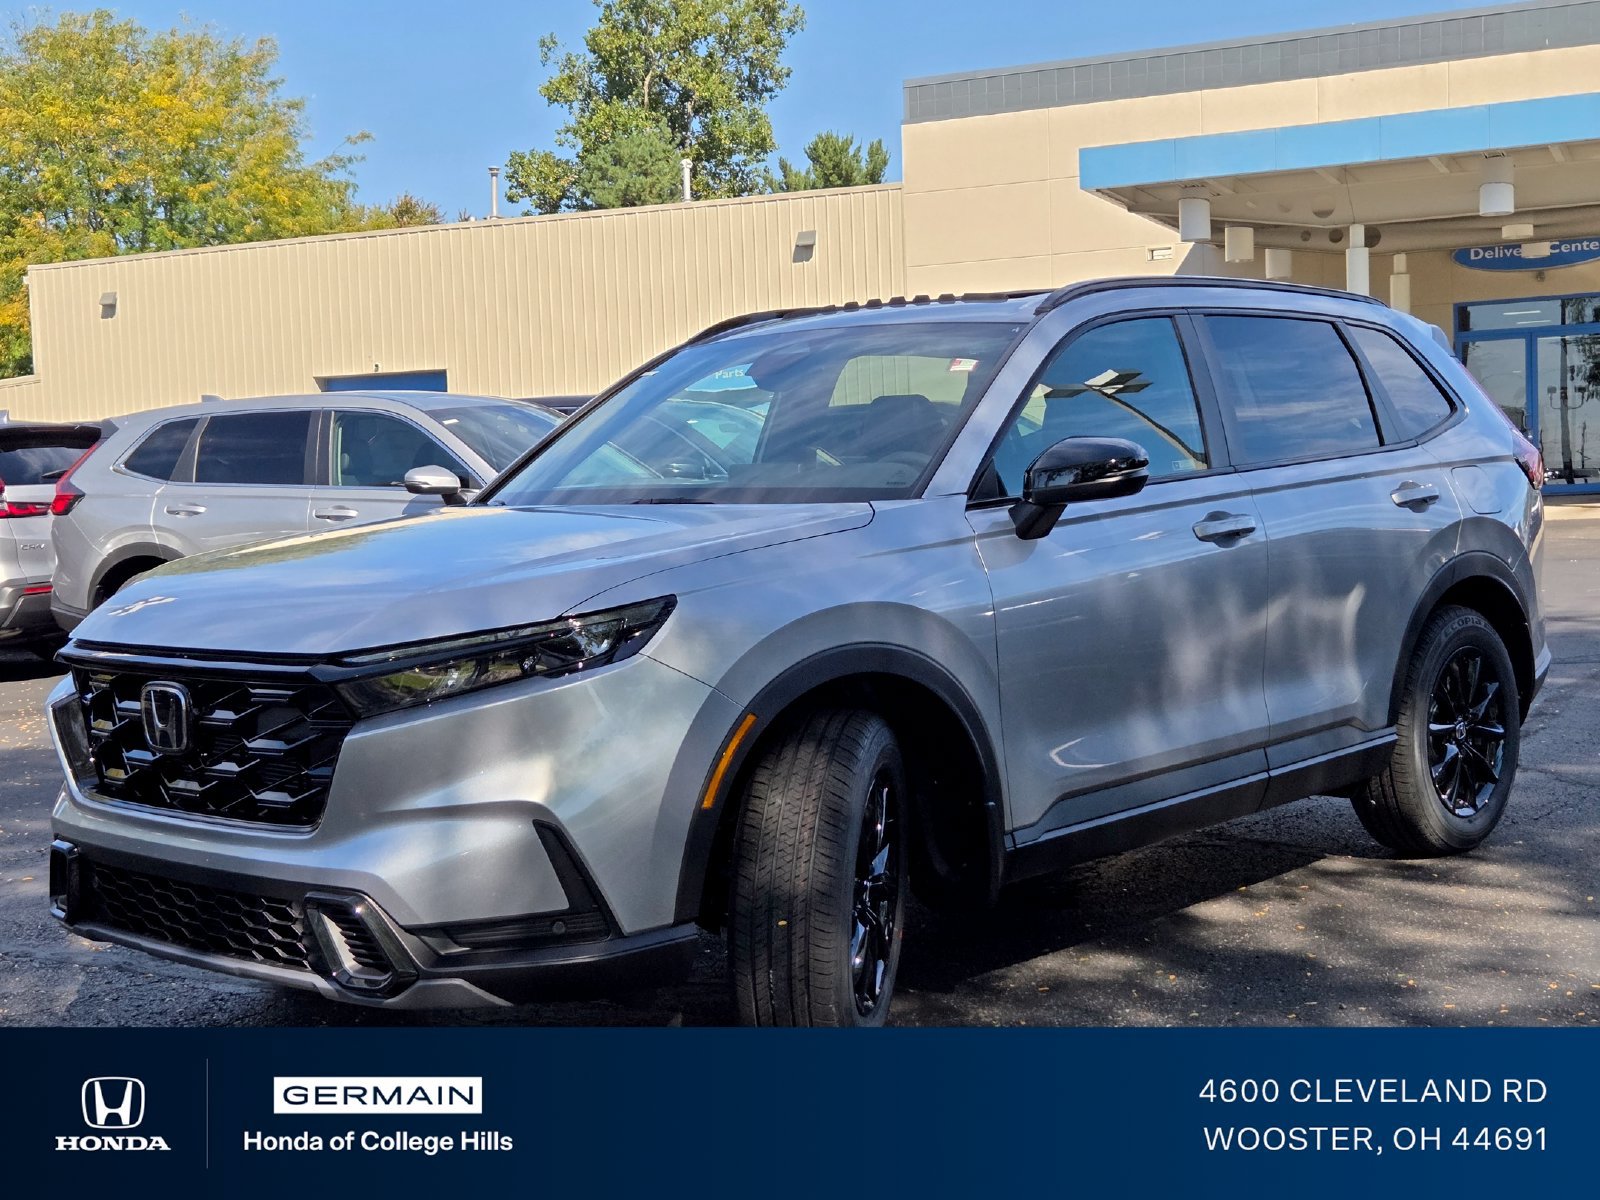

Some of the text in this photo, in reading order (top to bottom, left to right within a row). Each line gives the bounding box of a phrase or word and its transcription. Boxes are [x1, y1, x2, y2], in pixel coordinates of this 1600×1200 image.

[1470, 240, 1600, 261] Delive Cente
[715, 369, 744, 379] Parts
